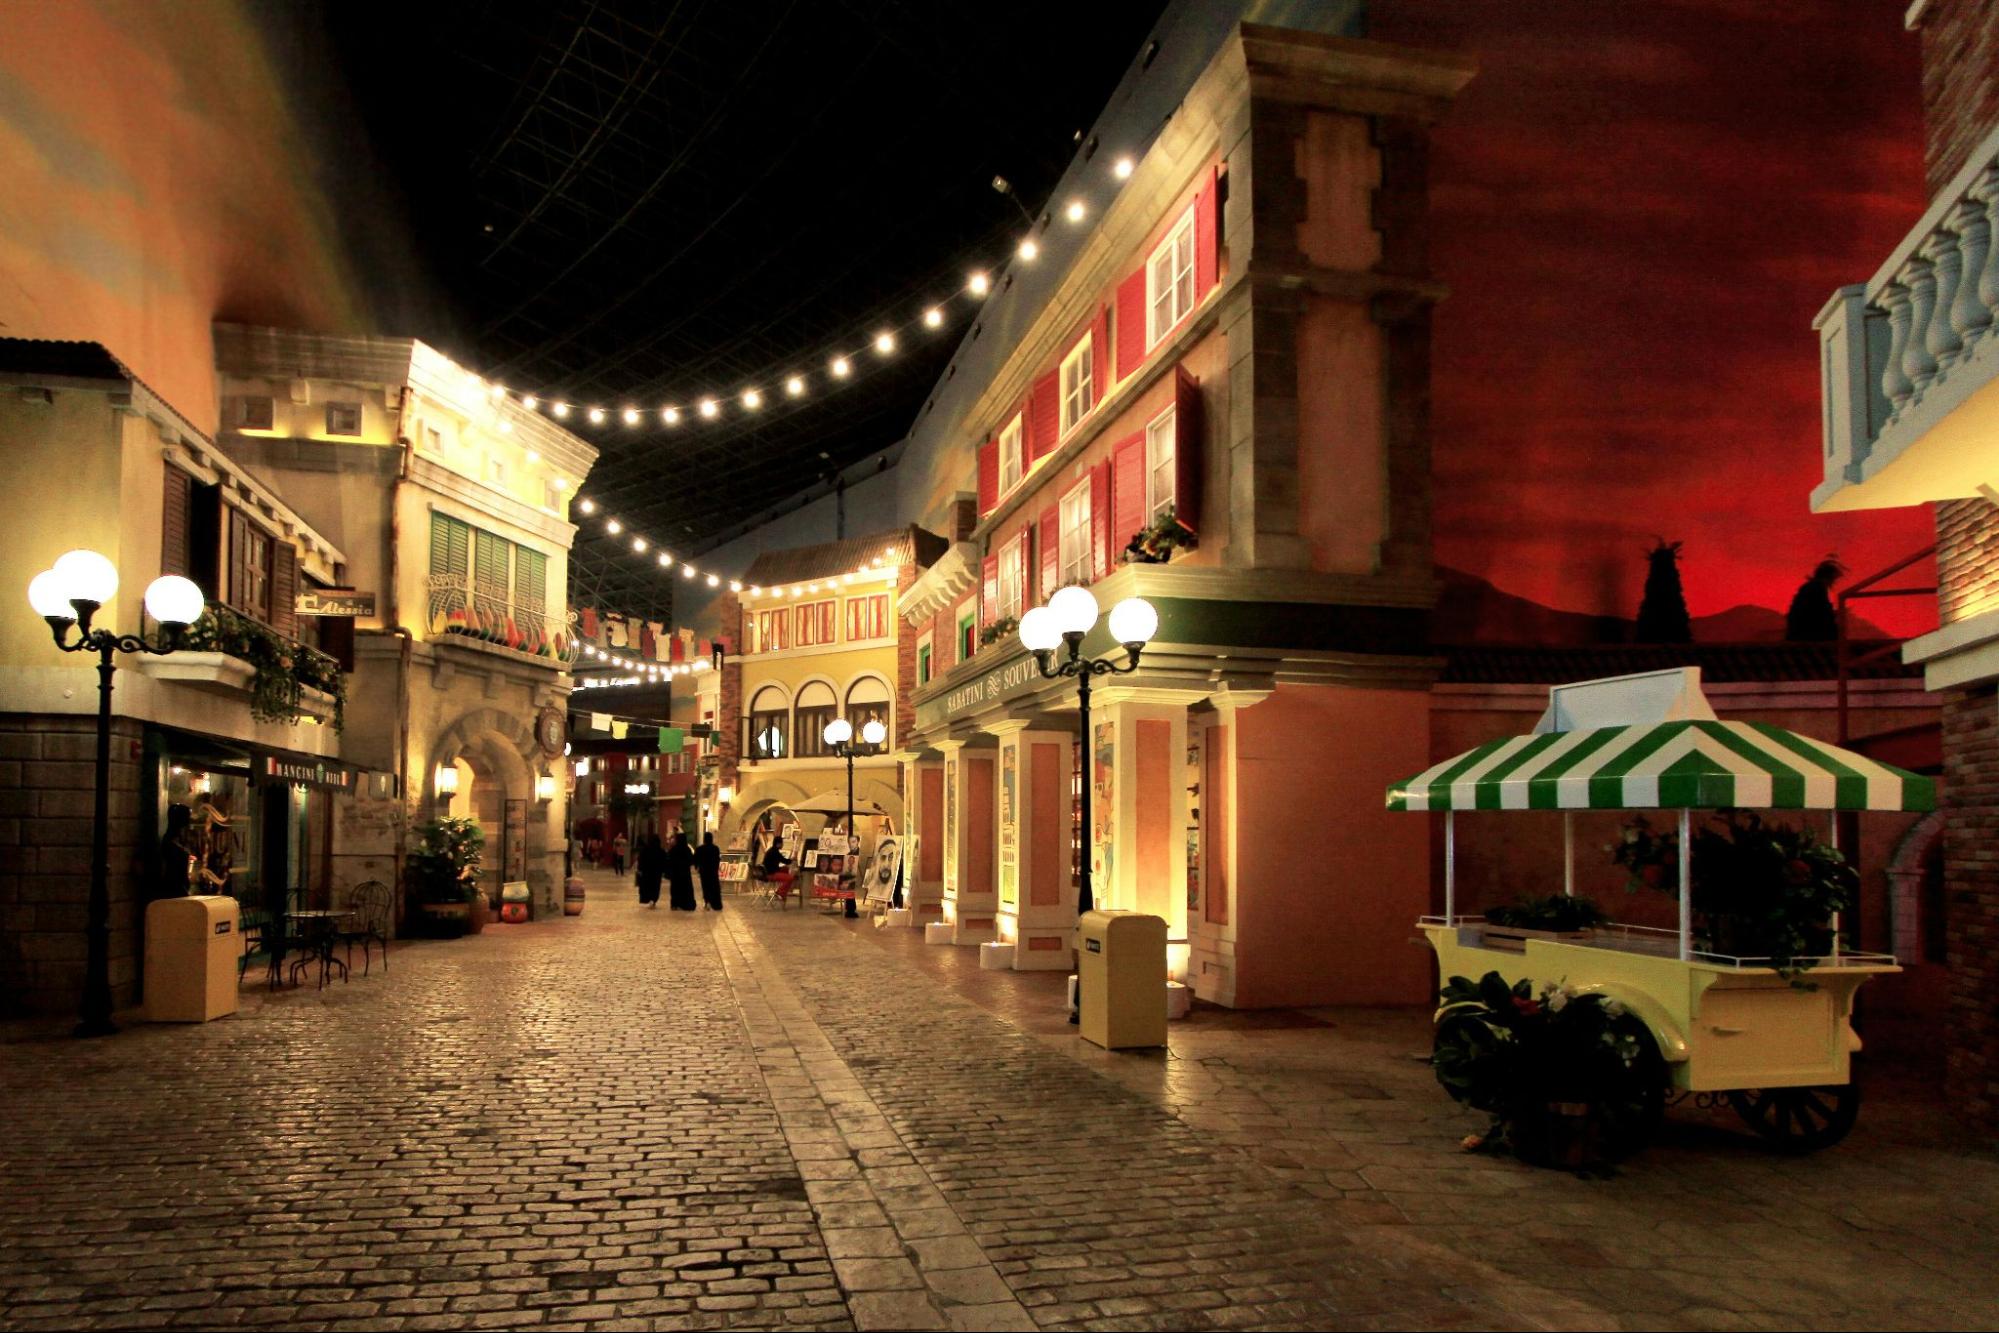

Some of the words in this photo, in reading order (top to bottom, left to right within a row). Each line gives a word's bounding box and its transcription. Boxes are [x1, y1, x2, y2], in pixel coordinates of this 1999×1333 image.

[320, 600, 373, 615] Alessia
[947, 681, 983, 714] SABATINI
[1004, 649, 1058, 690] SOUVER
[276, 763, 315, 781] MANCINI
